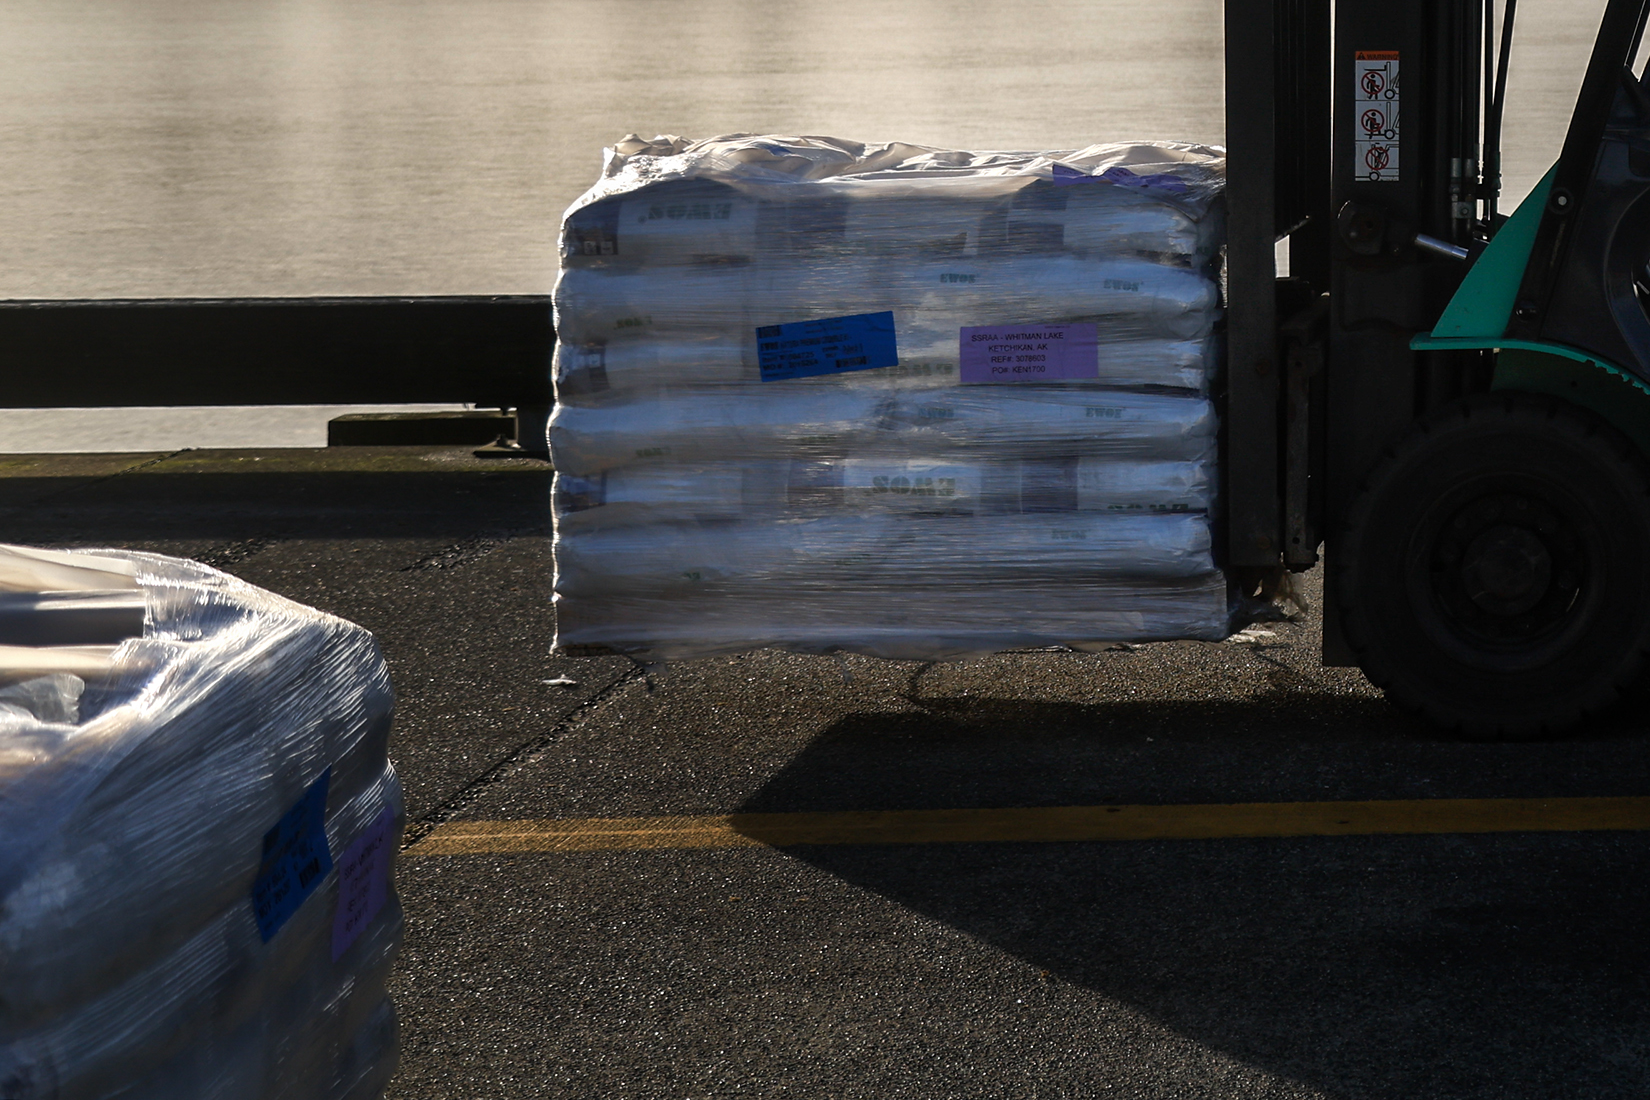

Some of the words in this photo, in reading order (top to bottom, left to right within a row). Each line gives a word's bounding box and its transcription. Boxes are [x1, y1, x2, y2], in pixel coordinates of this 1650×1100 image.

[971, 334, 999, 342] SSRAA
[1005, 333, 1042, 341] WHITMAN
[1044, 332, 1064, 340] LAKE
[1037, 343, 1048, 351] AK
[1016, 355, 1046, 363] 3078603
[1012, 365, 1046, 373] KEN1700
